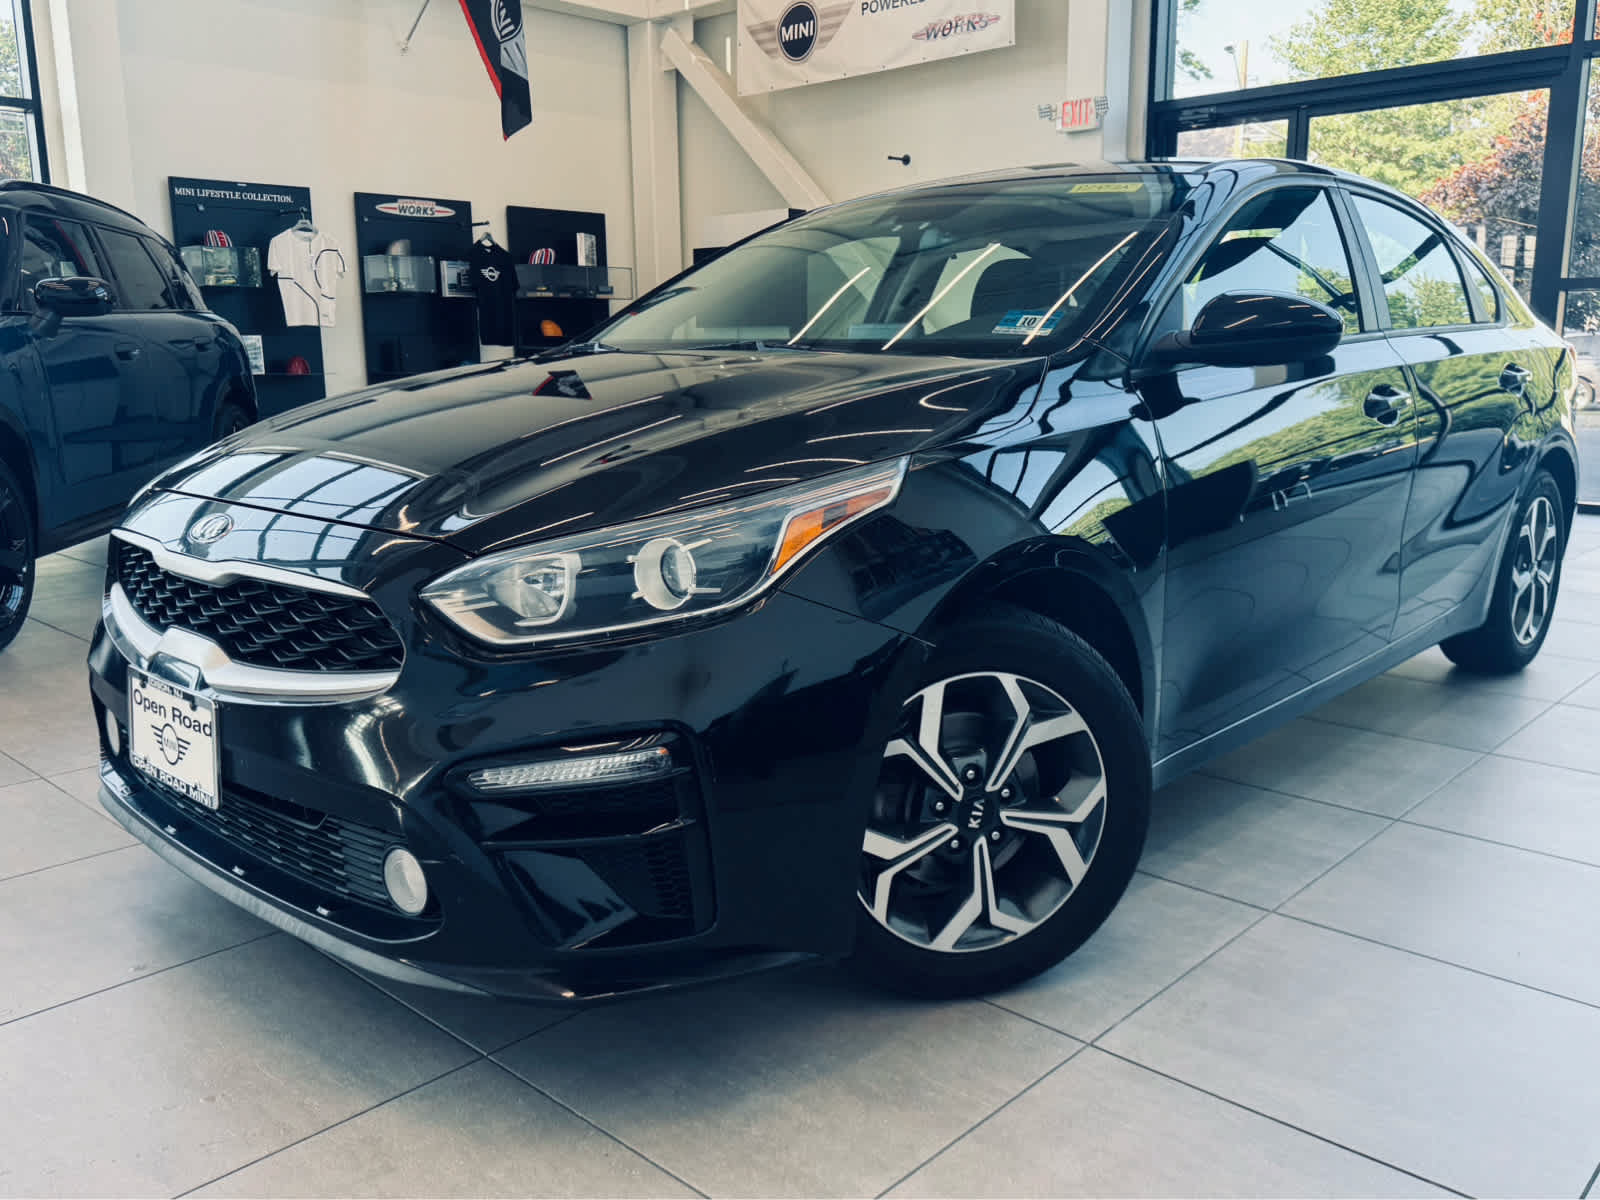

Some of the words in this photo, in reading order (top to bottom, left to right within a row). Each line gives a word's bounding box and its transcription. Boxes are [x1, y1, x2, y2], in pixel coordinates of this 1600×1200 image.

[780, 20, 815, 43] MINI
[1062, 98, 1092, 128] EXIT
[174, 187, 195, 197] MINI
[197, 189, 241, 200] LIFESTYLE
[242, 193, 294, 204] COLLECTION.
[398, 205, 436, 216] WORKS
[133, 688, 167, 719] Open
[171, 706, 212, 737] Road
[133, 756, 157, 779] OPEN
[160, 773, 186, 793] ROAD
[189, 785, 214, 809] MINI
[967, 799, 985, 829] KIA
